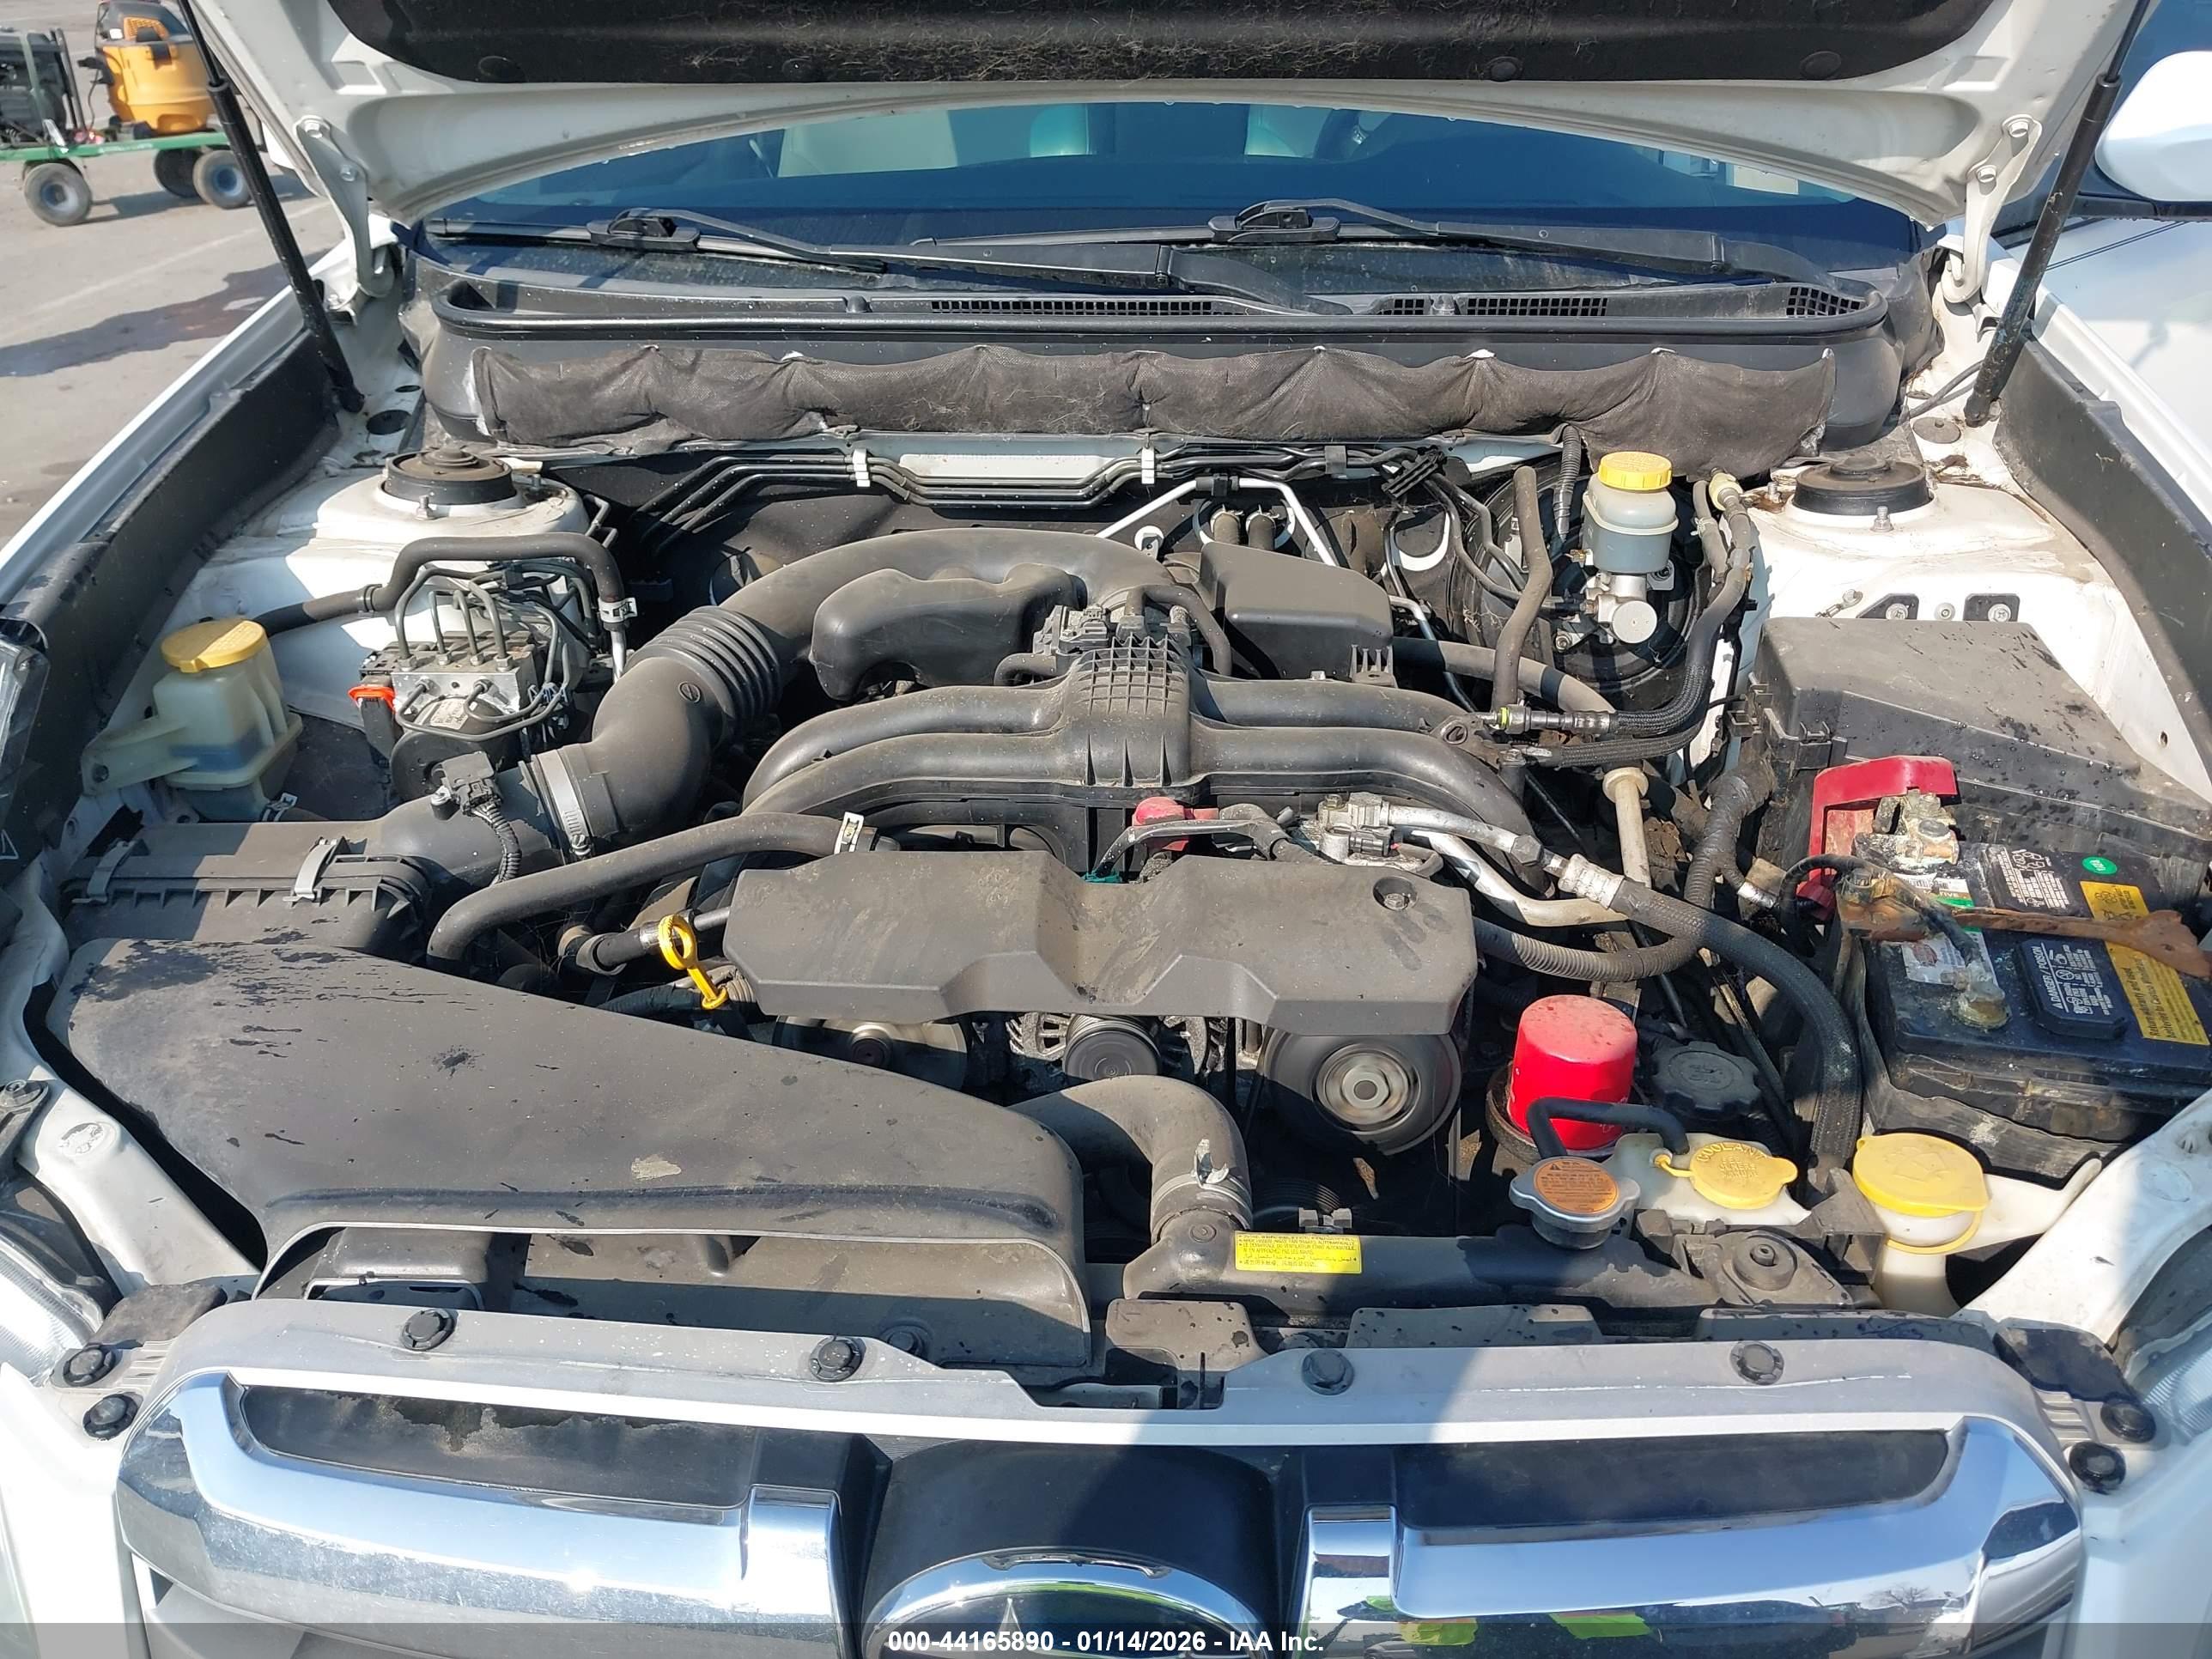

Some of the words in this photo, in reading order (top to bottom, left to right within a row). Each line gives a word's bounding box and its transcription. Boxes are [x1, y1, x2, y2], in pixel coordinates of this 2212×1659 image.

[2030, 945, 2049, 969] POISON
[2042, 975, 2061, 1003] DANGER
[2145, 1016, 2160, 1036] Return
[1697, 1142, 1766, 1163] COOLANT
